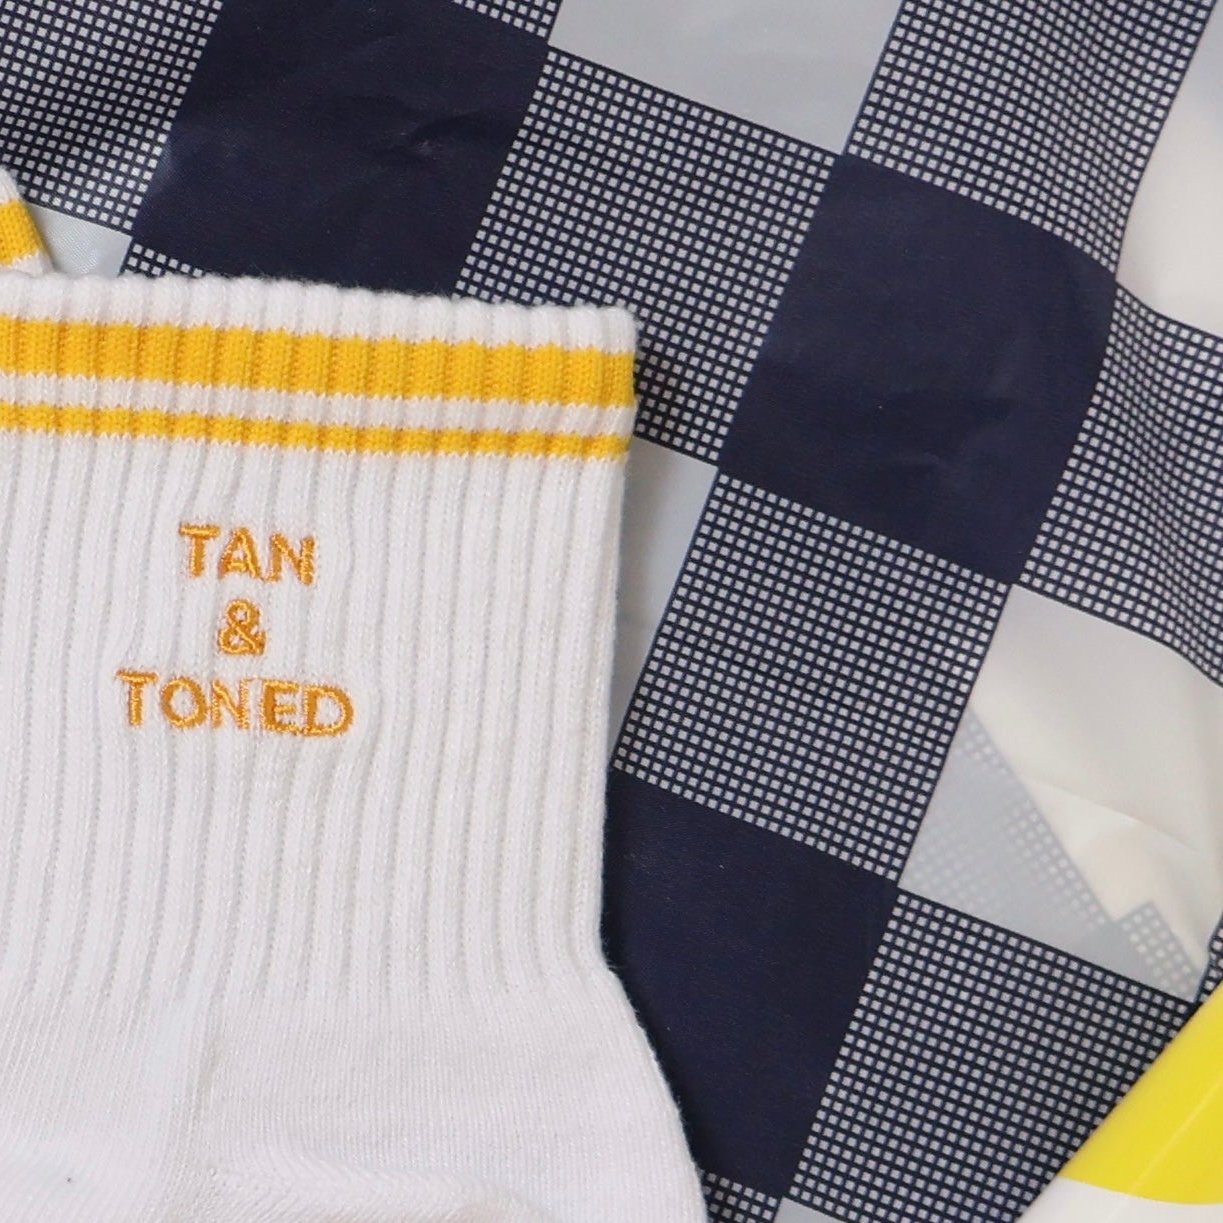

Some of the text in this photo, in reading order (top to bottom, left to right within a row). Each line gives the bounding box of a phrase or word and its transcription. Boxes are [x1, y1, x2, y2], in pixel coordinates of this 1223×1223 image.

[179, 522, 317, 585] TAN
[217, 599, 266, 656] &
[116, 668, 354, 737] TONED
